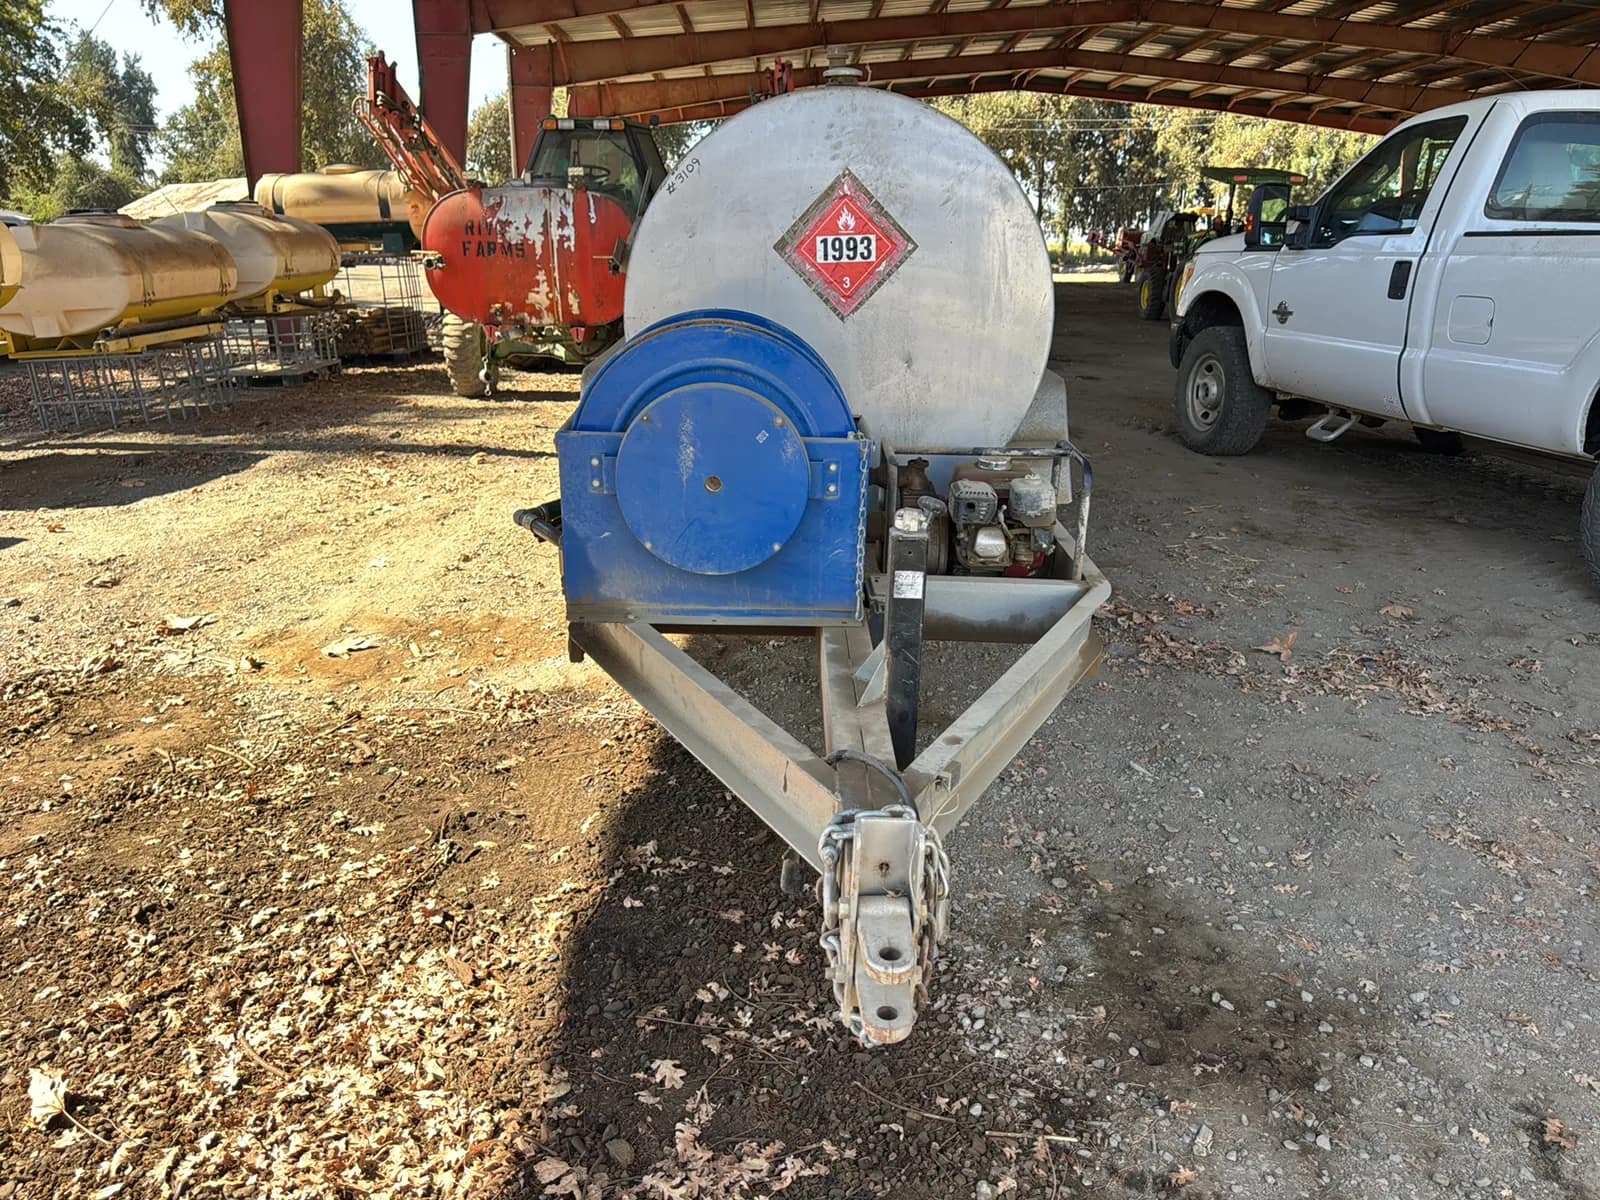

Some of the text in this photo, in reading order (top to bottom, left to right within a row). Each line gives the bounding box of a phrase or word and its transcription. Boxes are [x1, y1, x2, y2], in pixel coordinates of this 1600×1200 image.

[666, 158, 701, 194] #3109
[462, 240, 526, 258] FARMS
[820, 235, 873, 262] 1993
[842, 276, 851, 289] 3
